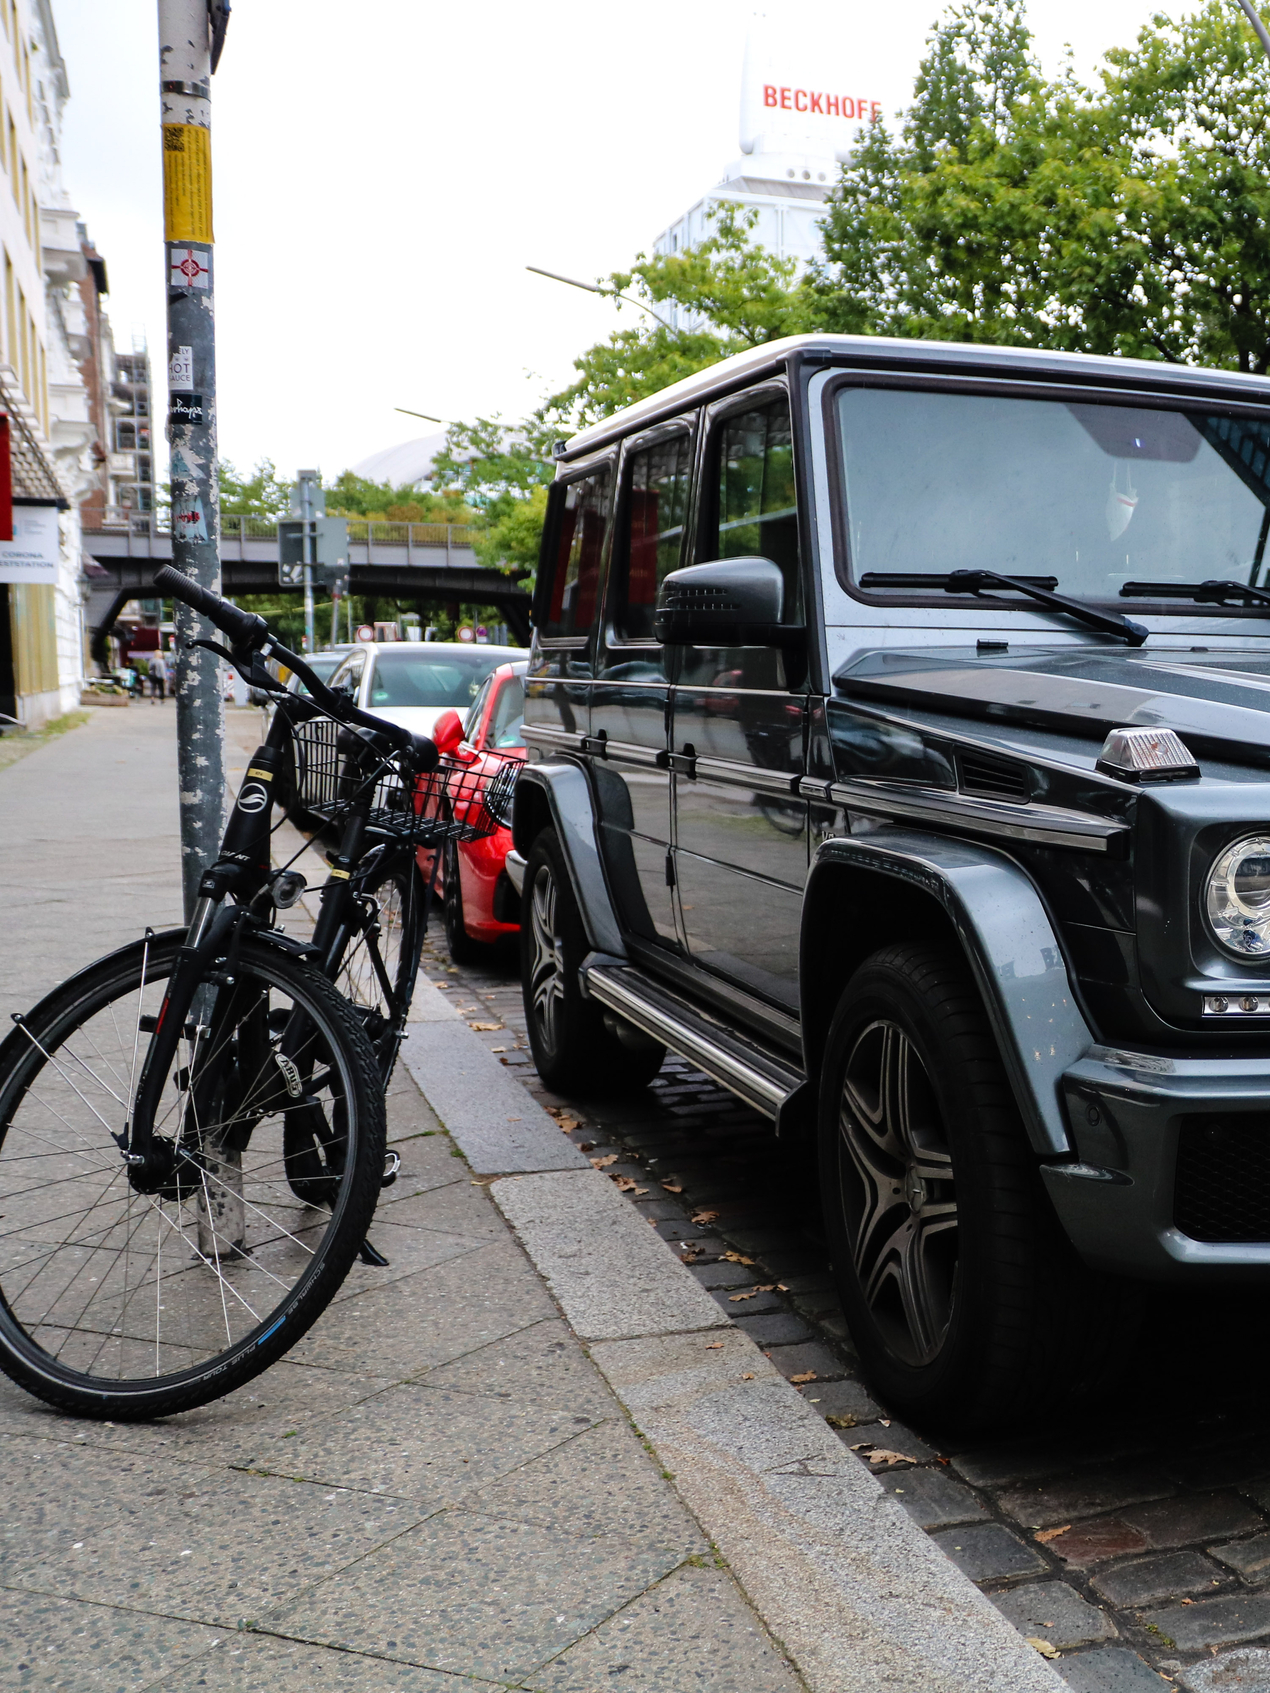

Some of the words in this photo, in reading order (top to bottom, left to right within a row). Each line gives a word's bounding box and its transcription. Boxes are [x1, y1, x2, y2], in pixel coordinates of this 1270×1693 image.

[763, 84, 882, 122] BECKHOFF
[2, 550, 43, 559] CORONA
[280, 1059, 298, 1091] ABUS
